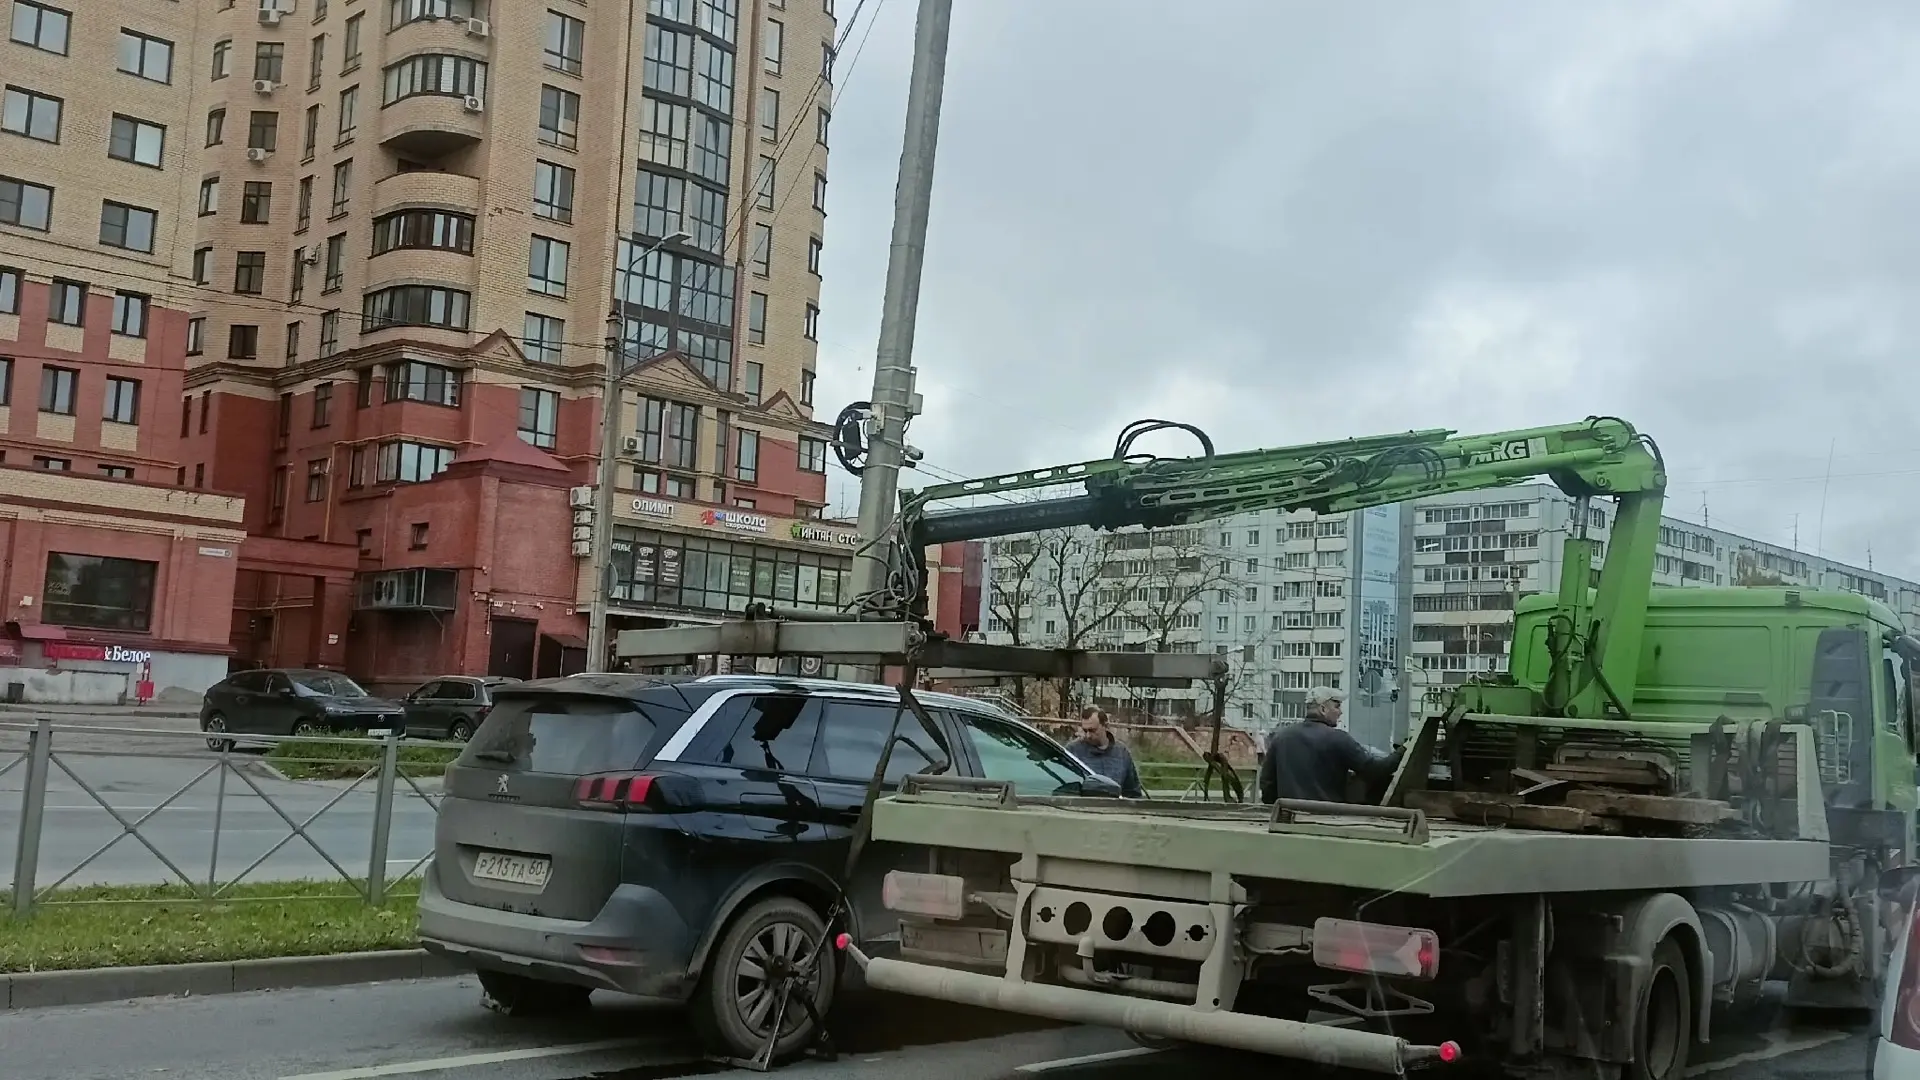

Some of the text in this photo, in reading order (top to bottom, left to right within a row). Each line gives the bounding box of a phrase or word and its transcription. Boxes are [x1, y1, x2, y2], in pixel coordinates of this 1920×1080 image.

[632, 498, 674, 515] ОЛИМП
[801, 526, 833, 542] ИНТАН
[112, 645, 151, 663] Белое
